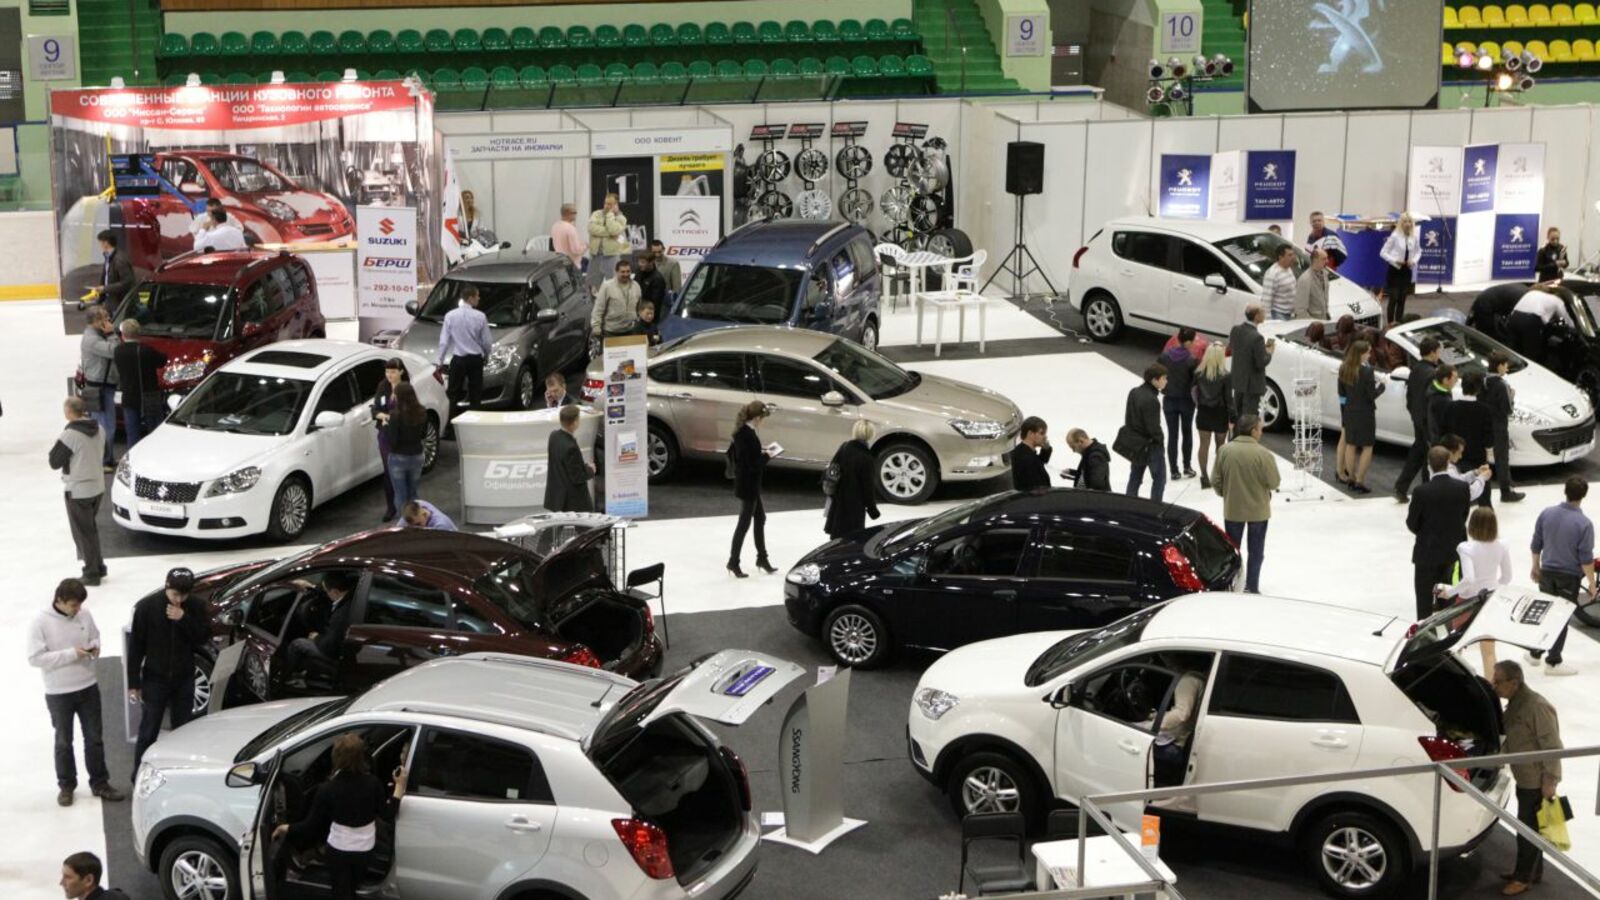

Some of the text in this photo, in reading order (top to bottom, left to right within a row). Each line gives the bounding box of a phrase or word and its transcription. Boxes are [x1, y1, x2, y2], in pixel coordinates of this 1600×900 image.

[1020, 19, 1033, 41] 9
[1168, 15, 1193, 37] 10
[43, 39, 60, 63] 9
[232, 105, 255, 114] ООО
[635, 136, 683, 144] ООО КОВЕНТ
[615, 175, 627, 203] 1
[368, 237, 407, 246] SUZUKI
[363, 256, 412, 268] БЕРШ
[373, 284, 414, 292] 292-10-01
[484, 460, 548, 478] БЕР
[791, 728, 801, 793] SSANGYONG
